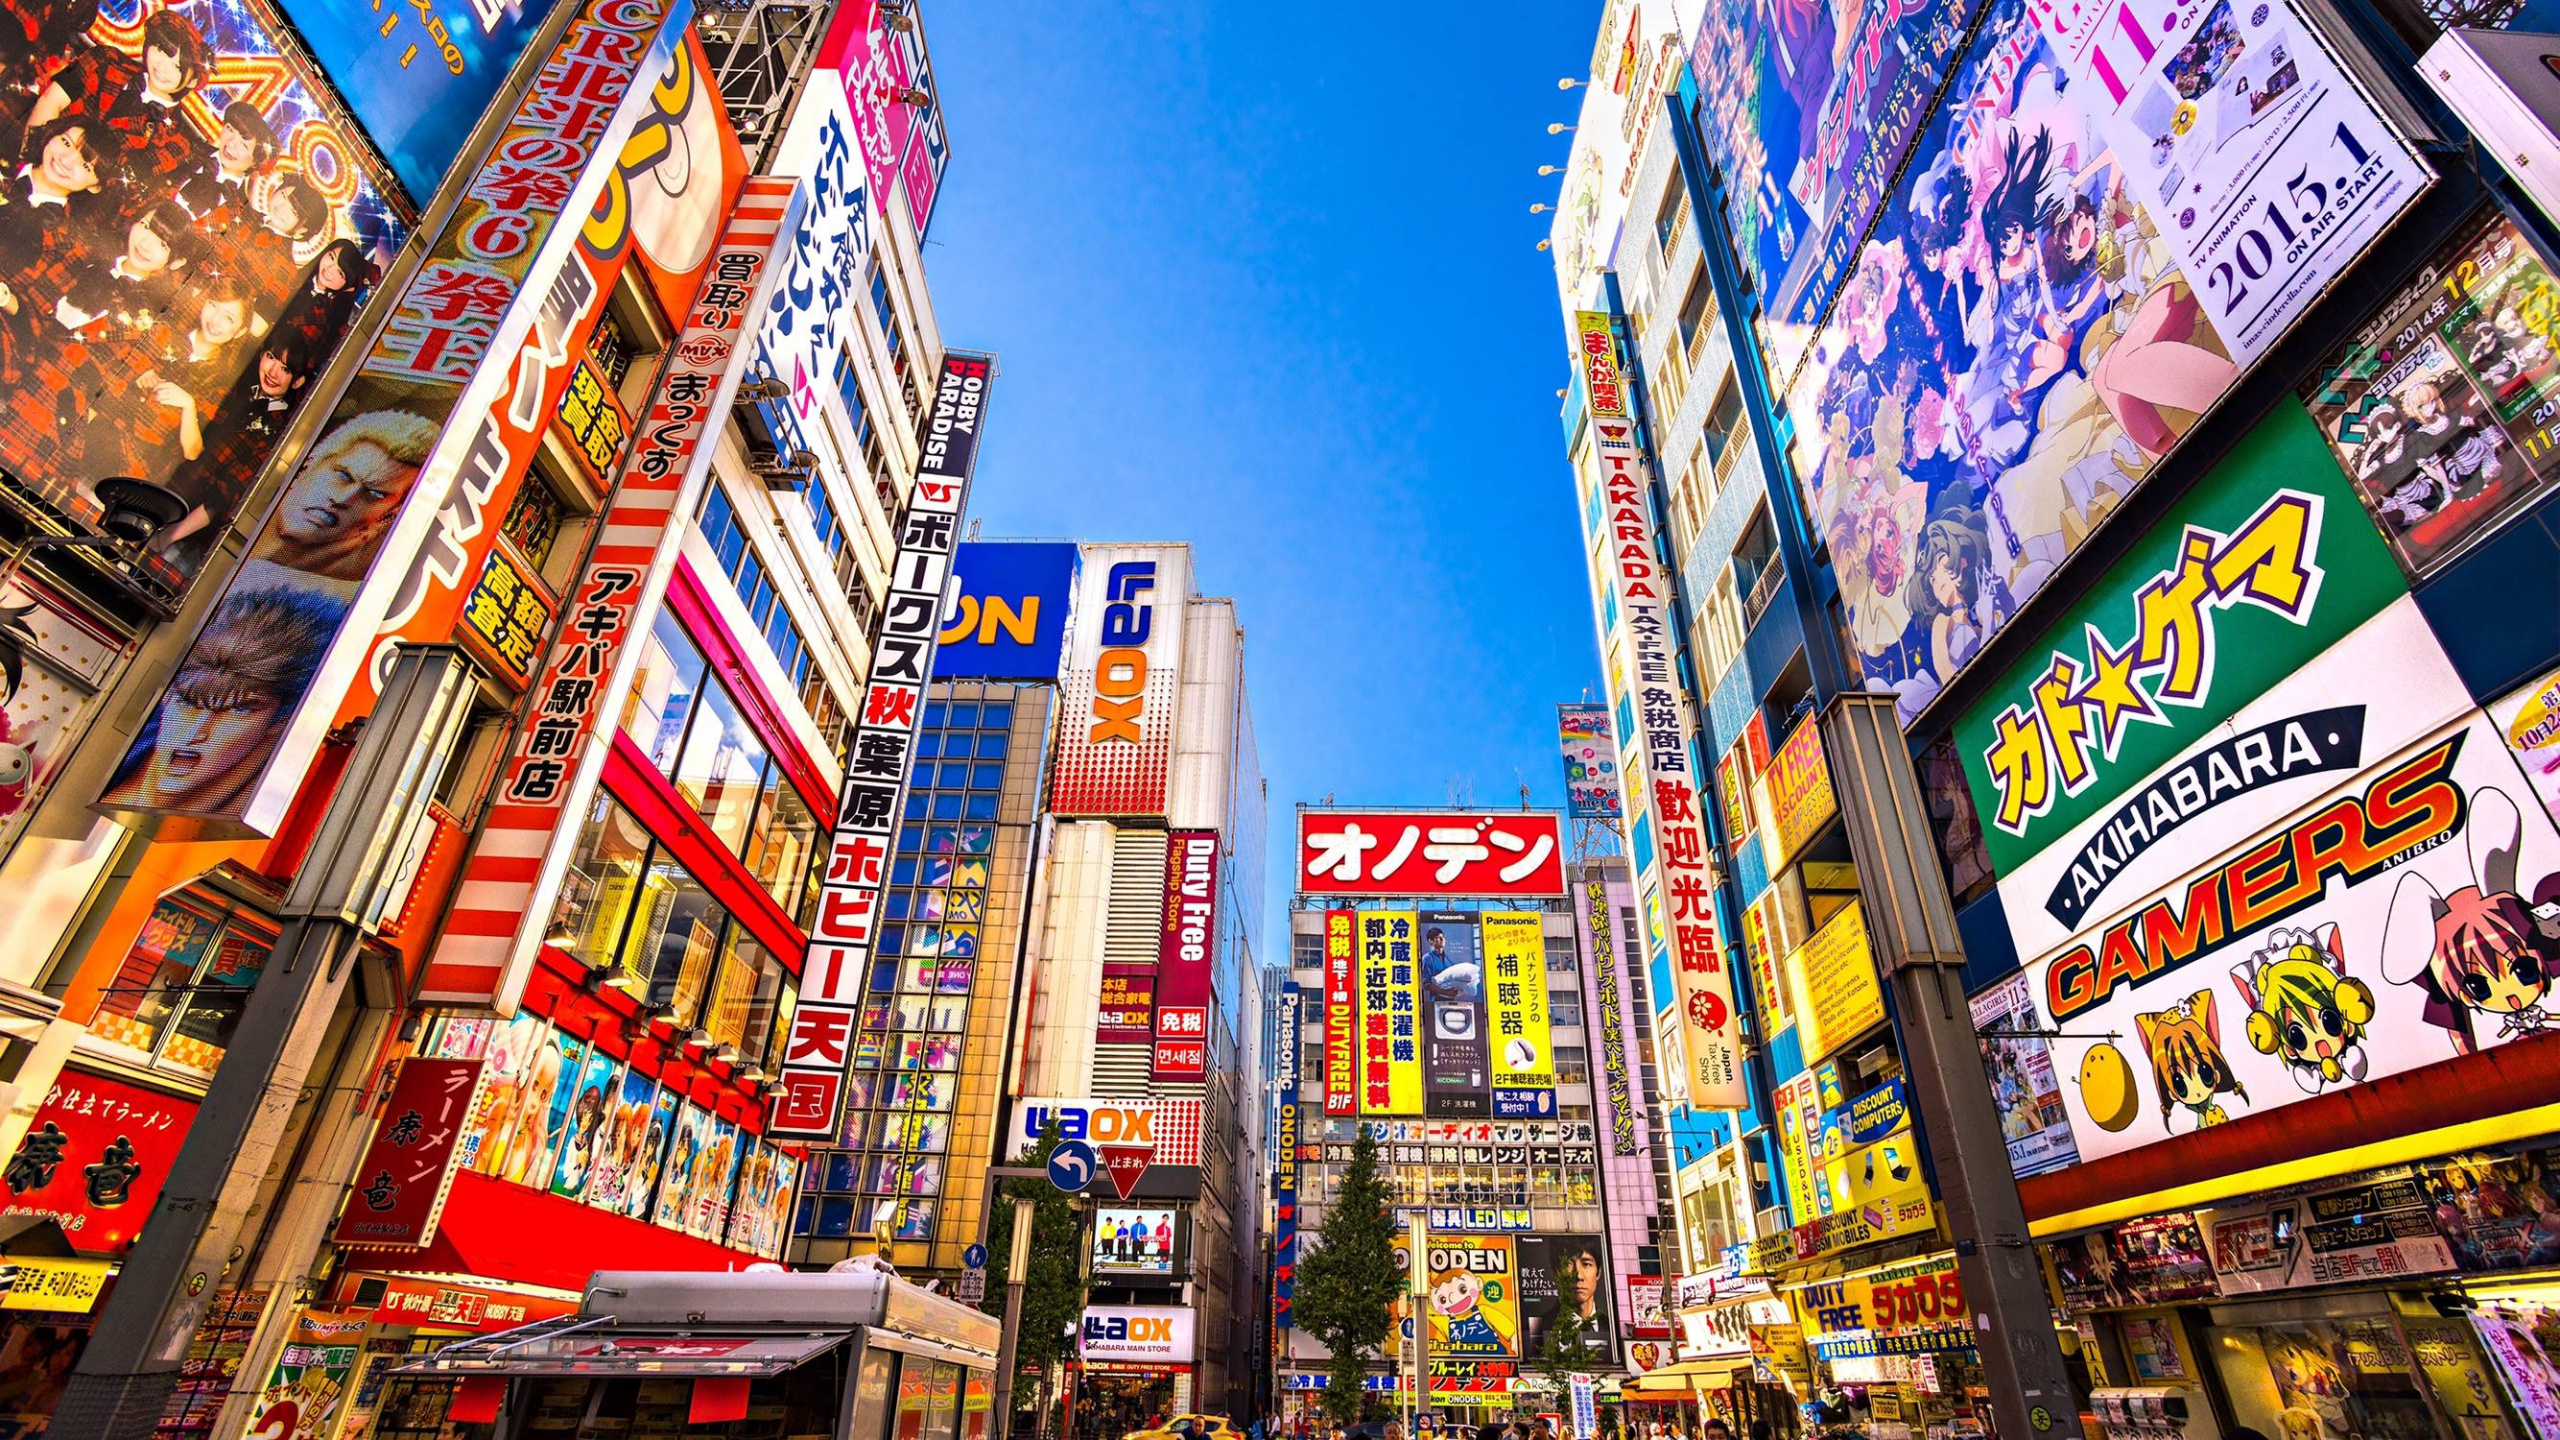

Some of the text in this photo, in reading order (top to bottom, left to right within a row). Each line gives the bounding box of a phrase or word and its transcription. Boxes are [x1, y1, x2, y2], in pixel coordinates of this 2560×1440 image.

[2181, 5, 2199, 31] ON
[2207, 121, 2376, 319] 2015.1
[2286, 238, 2309, 265] ON
[2311, 210, 2336, 241] AIR
[2335, 154, 2386, 212] START
[2193, 193, 2257, 270] TV ANIMATION
[702, 253, 763, 330] 買取り
[2242, 268, 2318, 351] imas-cinderella.com
[1582, 330, 1623, 411] まんが喫茶
[954, 362, 988, 435] HOBBY
[639, 374, 710, 478] まっくす
[922, 360, 966, 469] PARADISE
[1604, 455, 1657, 598] TAKARADA
[1628, 605, 1670, 683] TAX-FREE
[511, 571, 636, 800] アキバ駅前店
[1641, 686, 1686, 773] 免税商店
[1785, 717, 1824, 788] FREE
[2069, 721, 2323, 907] AKIHABARA
[1306, 816, 1555, 885] オノデン
[2380, 828, 2453, 872] ANIBRO
[1166, 838, 1185, 932] Flagship Store
[2044, 732, 2466, 1020] GAMERS
[1179, 839, 1214, 963] Duty Free
[1433, 914, 1466, 922] Panasonic
[1486, 916, 1539, 926] Panasonic
[1329, 915, 1351, 959] 免税
[1101, 992, 1151, 1005] 総合家電
[1102, 978, 1128, 990] 本店
[1496, 953, 1524, 1036] 補聴器
[1526, 951, 1541, 1025] パナソニックの
[1161, 1012, 1202, 1032] 免税
[1281, 992, 1299, 1092] Panasonic
[1158, 1049, 1201, 1065] 면세점
[1698, 1056, 1710, 1086] Shop
[1707, 1041, 1722, 1086] Tax-free
[1721, 1046, 1734, 1085] Japan.
[1494, 1073, 1553, 1086] 2F補聴器売場
[1327, 1093, 1353, 1110] B1F
[1441, 1100, 1478, 1109] 2F 洗濯機
[1496, 1090, 1536, 1103] 聞こえ相談
[1778, 1090, 1793, 1108] 2F
[1853, 1085, 1894, 1118] DISCOUNT
[408, 1068, 470, 1184] ラーメン
[1852, 1100, 1903, 1134] COMPUTERS
[1280, 1103, 1296, 1191] ONODEN
[1534, 1148, 1594, 1165] オーディオ
[1825, 1135, 1840, 1155] 2F
[1109, 1156, 1144, 1169] 止まれ
[1465, 1208, 1532, 1229] LED 照明
[1818, 1208, 1859, 1234] DISCOUNT
[1464, 1241, 1475, 1251] to
[1522, 1236, 1544, 1244] Panasonic
[1750, 1232, 1781, 1253] DISCOUNT
[1795, 1231, 1808, 1254] 2F
[1815, 1223, 1871, 1253] GSM MOBILES
[1394, 1248, 1507, 1273] OODEN
[1521, 1267, 1545, 1280] 教えて
[1749, 1248, 1788, 1271] COMPUTERS
[1486, 1285, 1500, 1299] 迎
[1521, 1279, 1557, 1290] あげたい
[1804, 1281, 1846, 1309] DUTY
[1871, 1270, 1967, 1327] タカラダ
[1818, 1304, 1866, 1333] FREE
[282, 1345, 359, 1370] 毎週木曜日
[1127, 1343, 1172, 1353] MAIN STORE
[1757, 1366, 1773, 1380] 2F
[1773, 1361, 1801, 1369] DISCOUNT
[265, 1379, 313, 1404] ポイント
[1447, 1394, 1483, 1405] ONODEN
